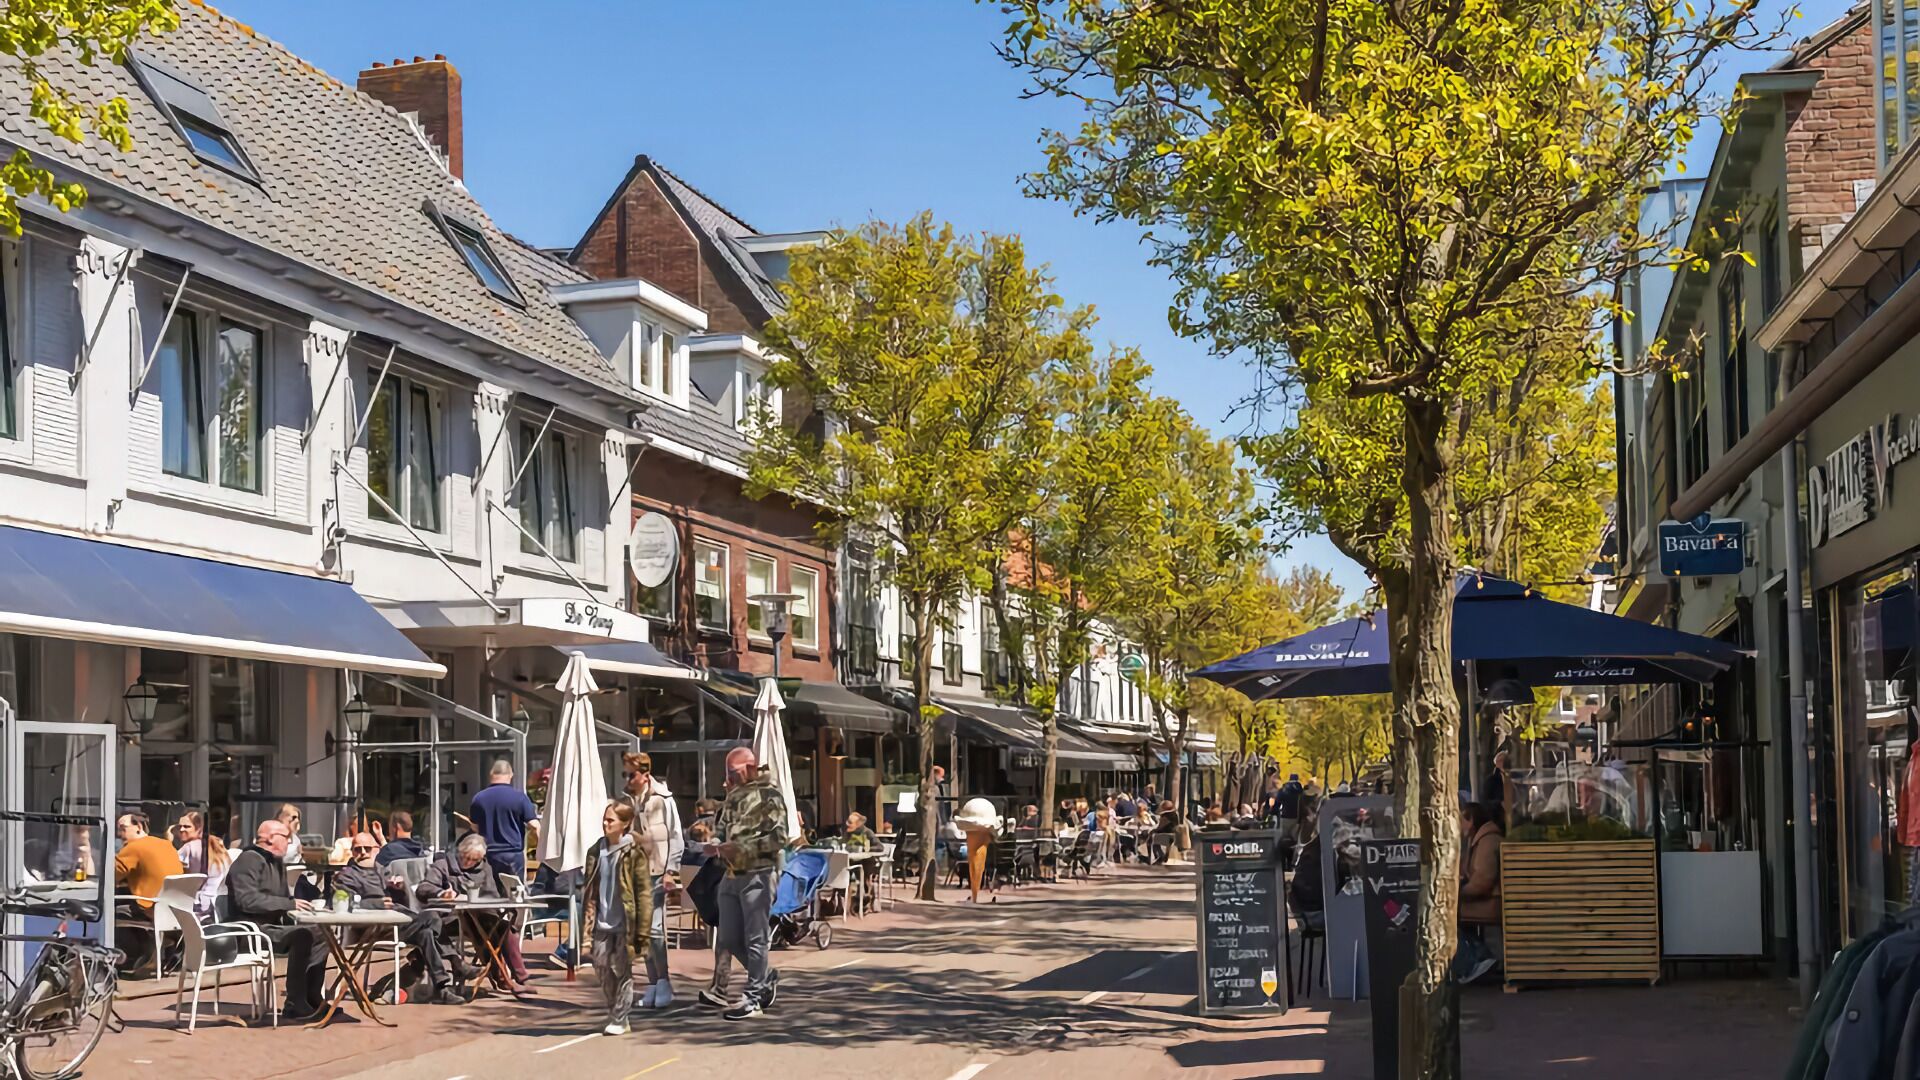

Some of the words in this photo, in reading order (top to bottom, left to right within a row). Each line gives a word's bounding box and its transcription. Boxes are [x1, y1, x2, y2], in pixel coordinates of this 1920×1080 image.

[1809, 433, 1863, 549] D-HAIR
[1664, 536, 1738, 552] Bavara
[1366, 844, 1419, 864] D-HAIR
